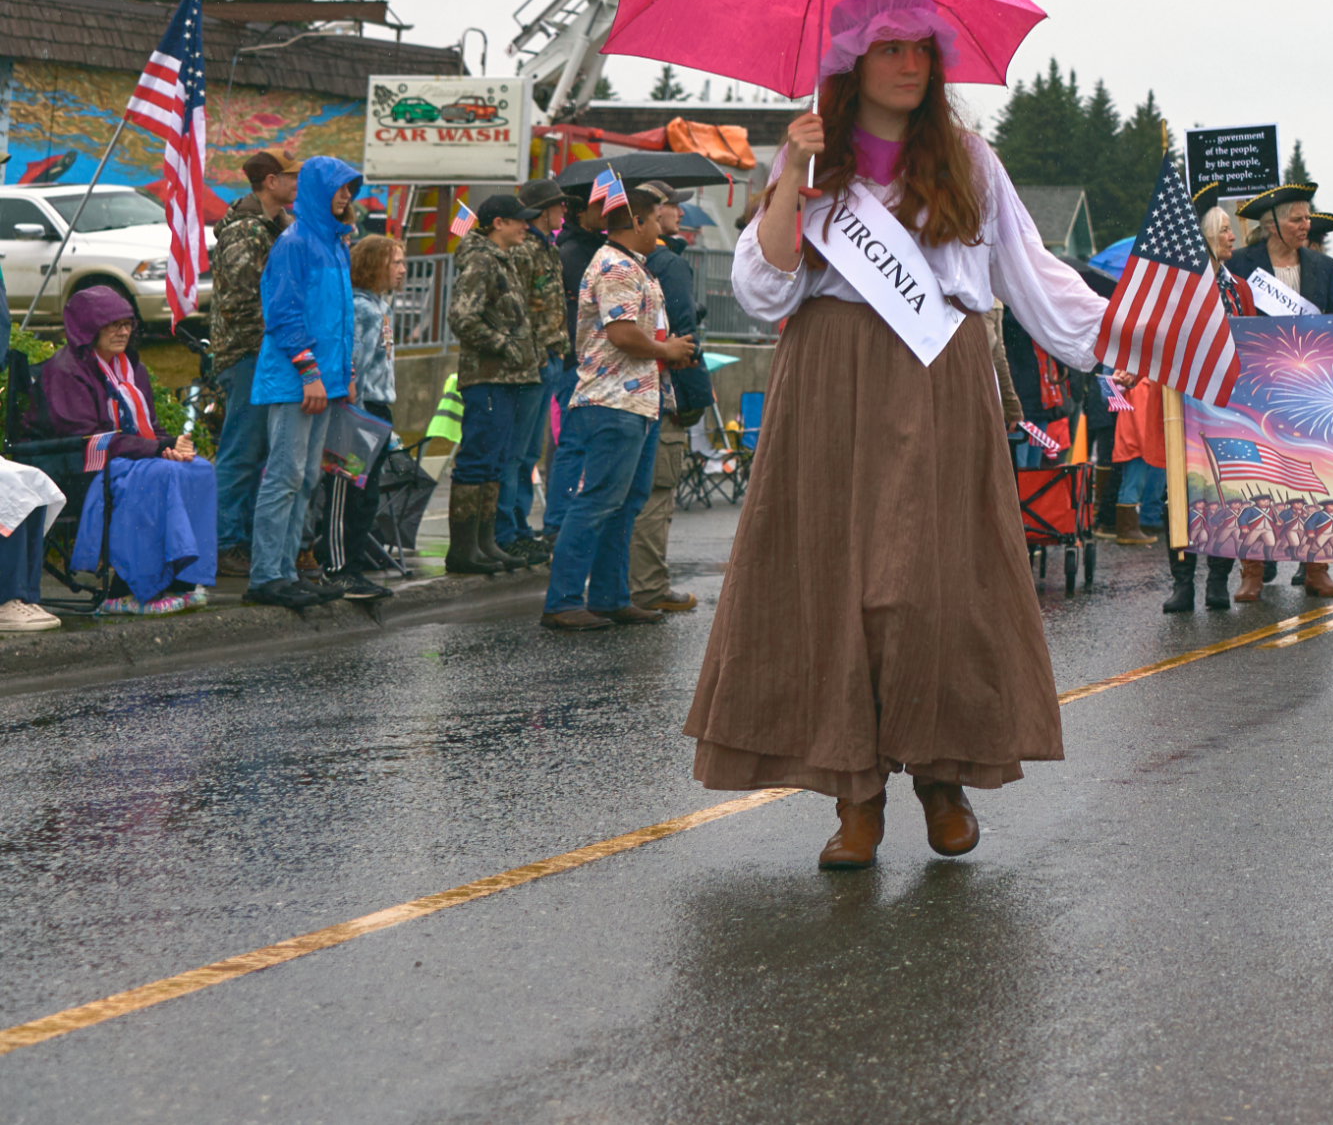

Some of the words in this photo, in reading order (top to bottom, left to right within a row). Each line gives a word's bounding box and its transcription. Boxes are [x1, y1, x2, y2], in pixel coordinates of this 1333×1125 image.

[374, 128, 427, 142] CAR
[437, 128, 510, 142] WASH
[1217, 132, 1264, 144] government
[1205, 148, 1214, 156] of
[1215, 147, 1228, 155] the
[1230, 145, 1259, 156] people,
[1205, 161, 1216, 170] by
[1217, 160, 1230, 168] the
[1232, 158, 1260, 169] people,
[1198, 173, 1210, 182] for
[1211, 172, 1224, 180] the
[833, 205, 927, 315] VIRGINIA
[1251, 275, 1313, 316] PENNSYLV
